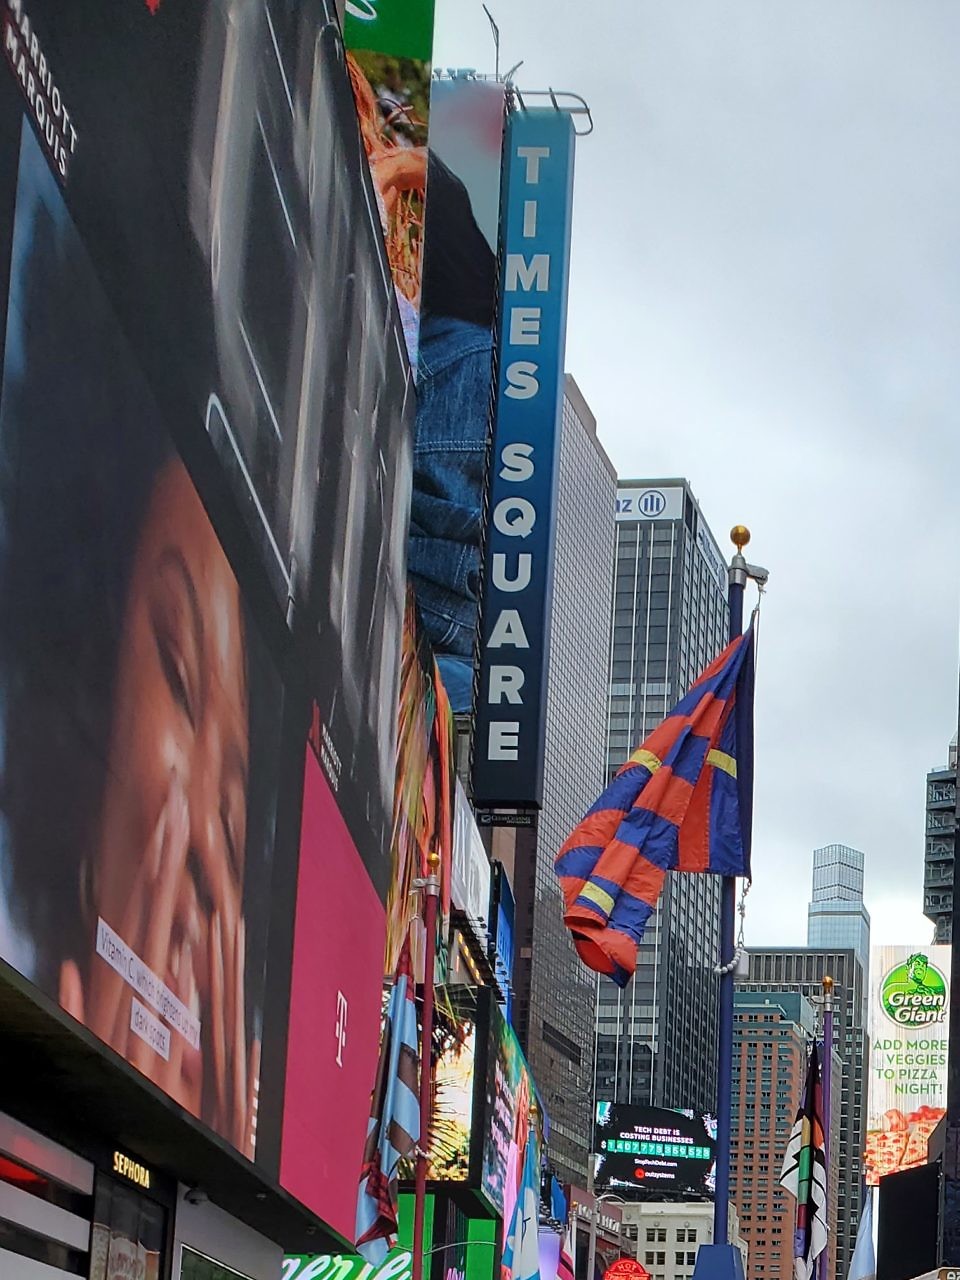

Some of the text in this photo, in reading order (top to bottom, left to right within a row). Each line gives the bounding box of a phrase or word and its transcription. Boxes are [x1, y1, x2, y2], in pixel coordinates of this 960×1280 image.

[7, 0, 78, 154] MARRIOTT
[6, 23, 67, 176] MARQUIS
[487, 146, 551, 761] TIMES SQUARE
[888, 990, 945, 1007] Green
[894, 1006, 947, 1023] Giant
[873, 1039, 948, 1051] ADD MORE
[886, 1054, 946, 1066] VEGGIES
[876, 1069, 938, 1080] TO PIZZA
[894, 1083, 943, 1095] NIGHT!
[620, 1132, 694, 1145] COSTING BUSINESSES
[634, 1126, 652, 1135] TECH
[653, 1127, 672, 1136] DEBT
[113, 1151, 151, 1189] SEPHORA
